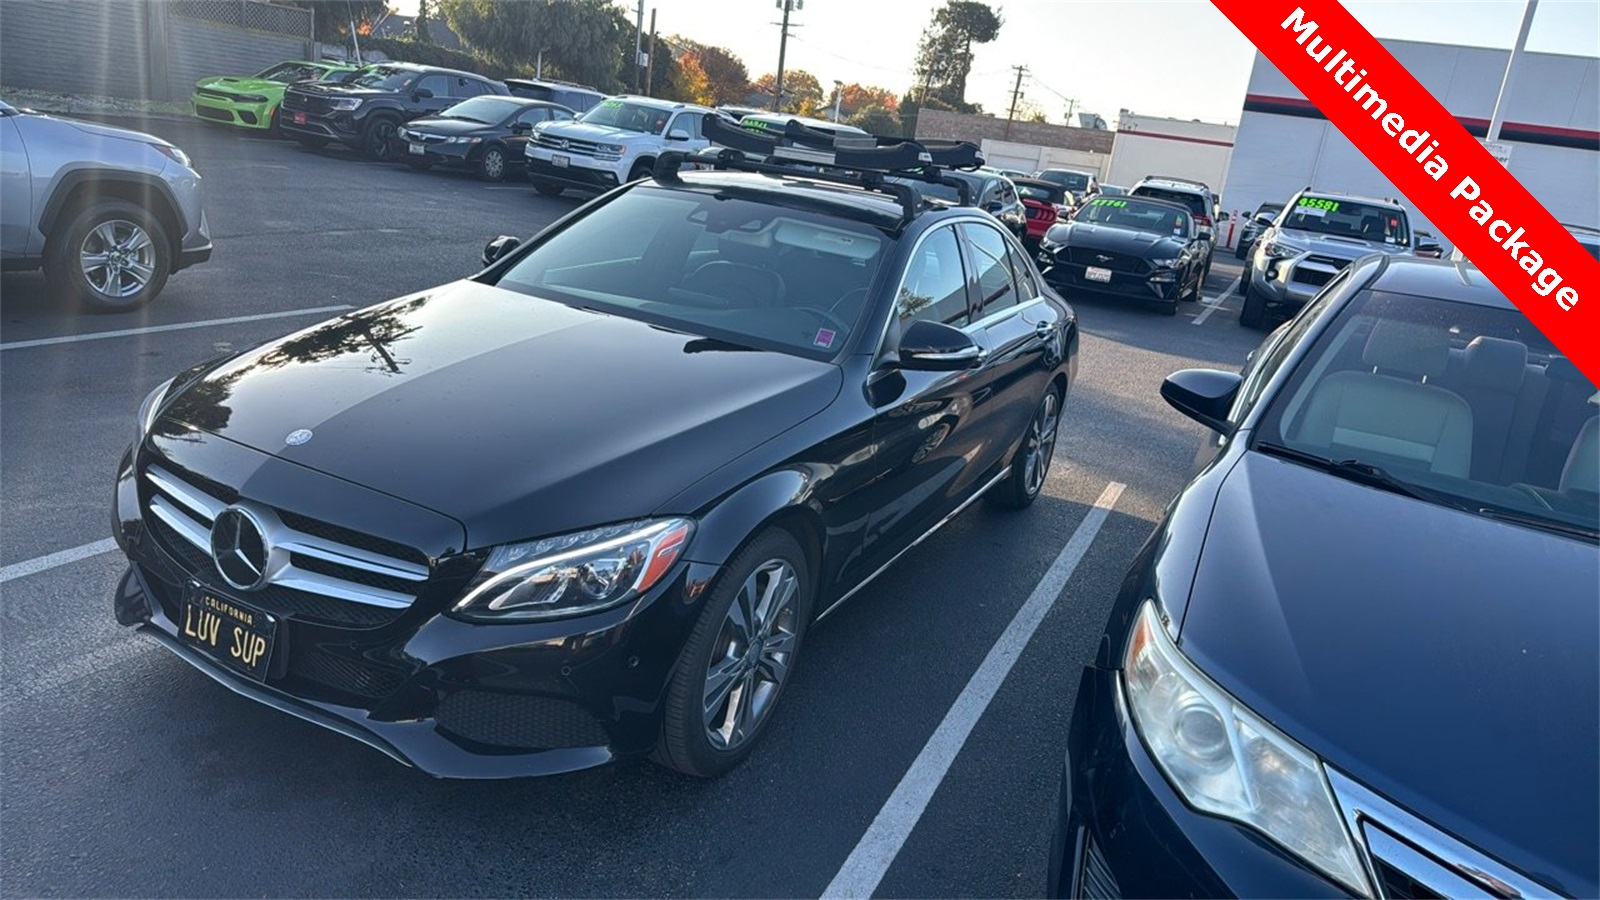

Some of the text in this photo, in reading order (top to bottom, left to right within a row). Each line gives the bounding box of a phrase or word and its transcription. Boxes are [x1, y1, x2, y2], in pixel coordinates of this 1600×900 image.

[205, 596, 252, 625] CALIFORNIA
[185, 604, 266, 667] LUV SUP
